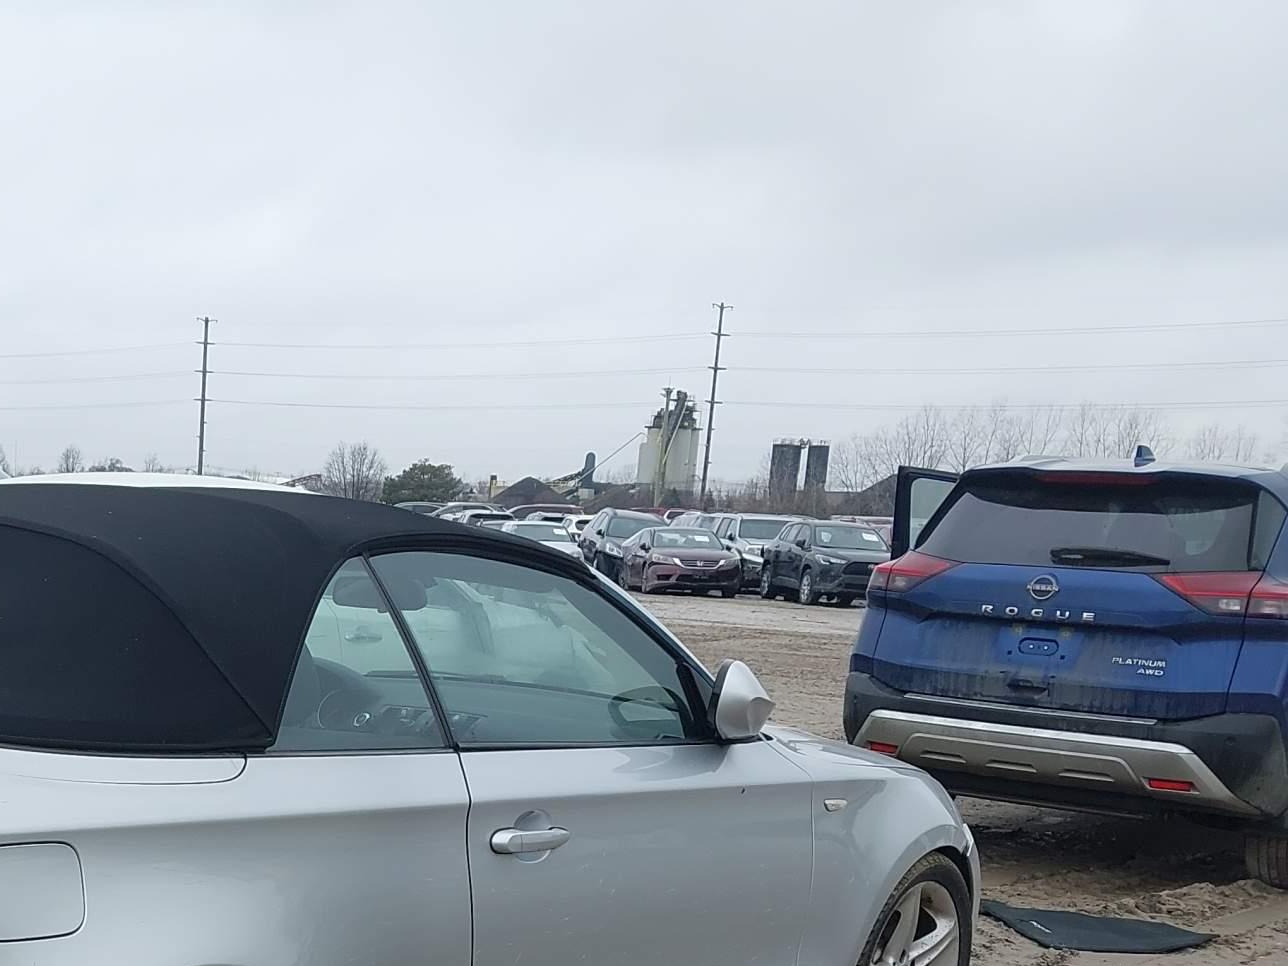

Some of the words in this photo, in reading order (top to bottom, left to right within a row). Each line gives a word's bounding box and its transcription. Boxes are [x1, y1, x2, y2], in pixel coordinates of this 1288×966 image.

[981, 604, 1096, 621] ROGUE
[1111, 656, 1166, 668] PLATINUM
[1136, 668, 1164, 676] AWD
